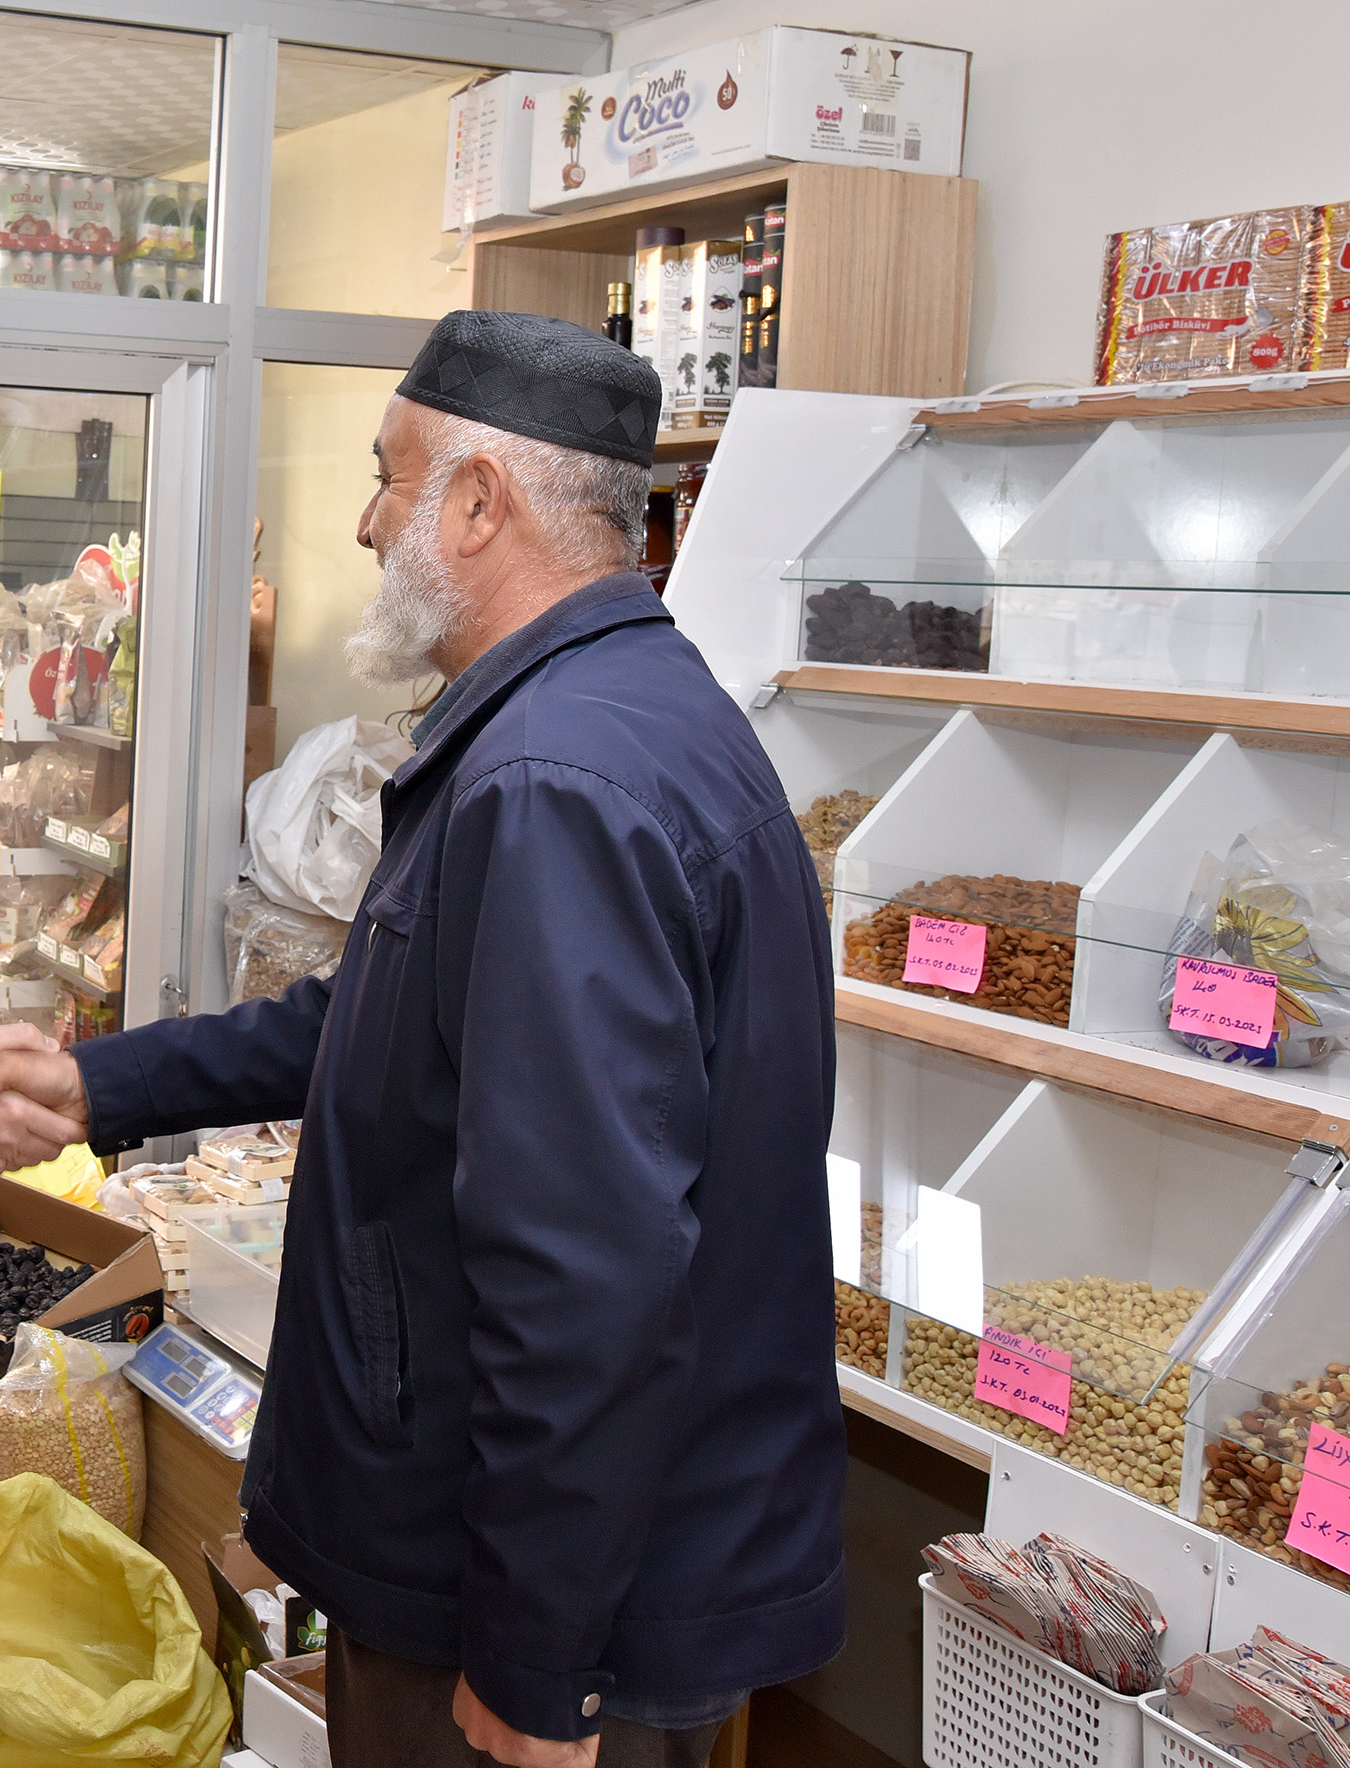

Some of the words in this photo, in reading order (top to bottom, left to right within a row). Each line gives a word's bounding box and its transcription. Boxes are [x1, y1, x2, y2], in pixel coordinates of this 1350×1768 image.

[645, 69, 686, 102] Multi
[617, 90, 691, 143] Coco
[1132, 260, 1253, 301] ÜLKER
[1172, 318, 1211, 330] Bisküvi
[989, 1350, 1011, 1366] 120
